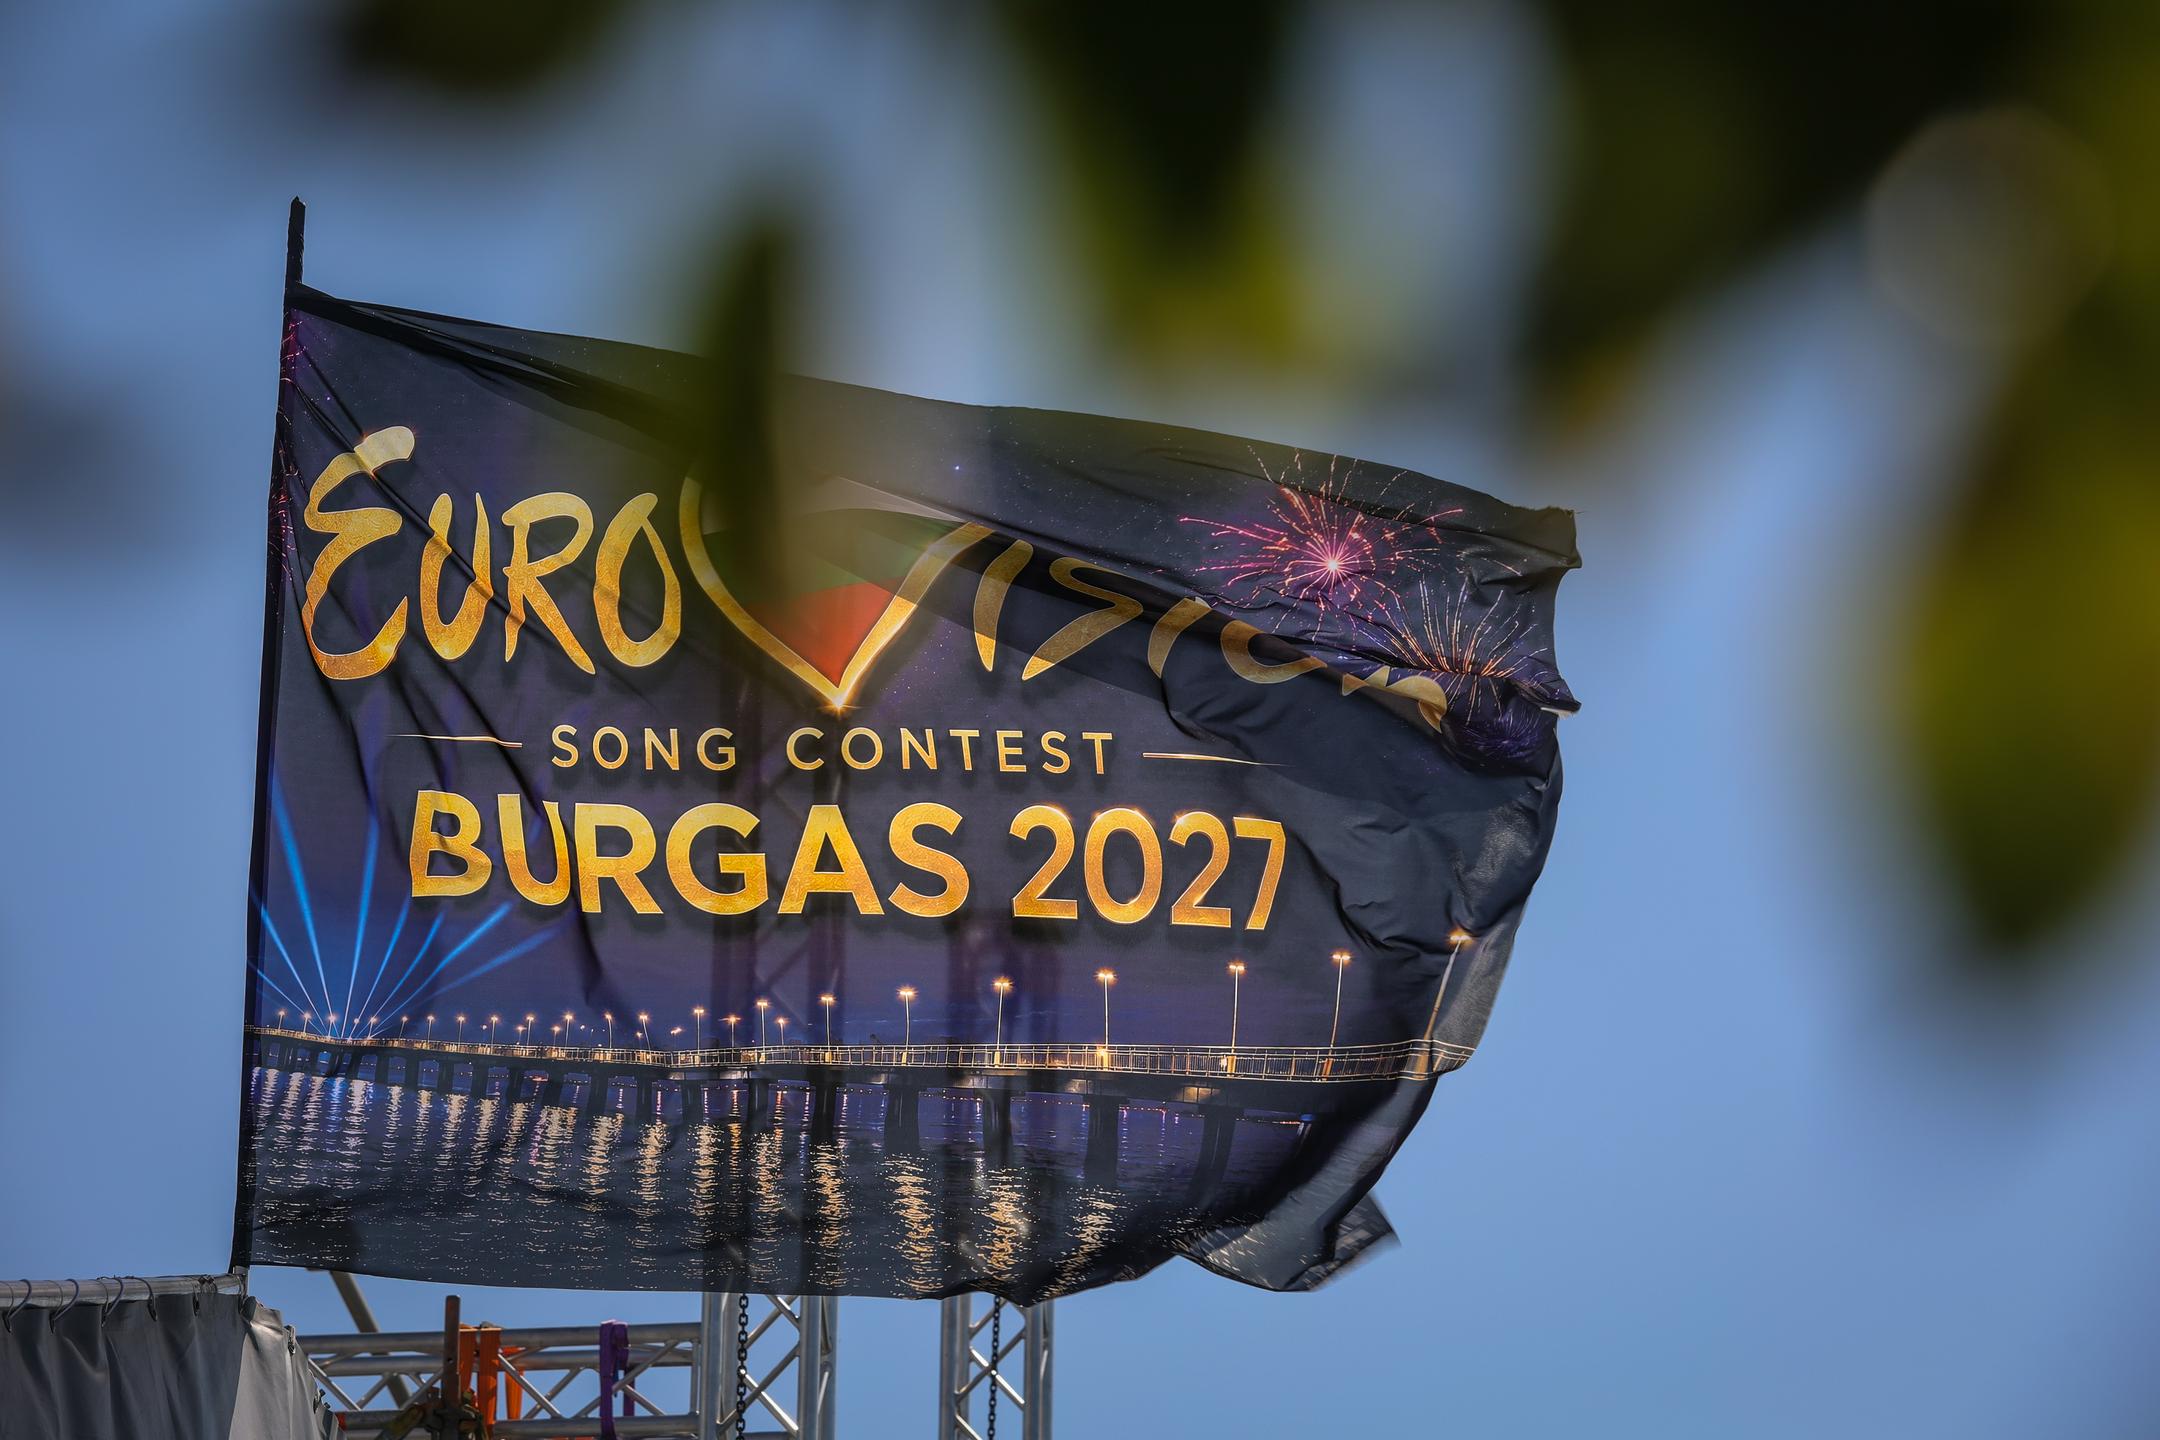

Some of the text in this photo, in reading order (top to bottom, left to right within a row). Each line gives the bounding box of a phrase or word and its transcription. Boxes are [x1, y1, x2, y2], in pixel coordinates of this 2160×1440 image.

[551, 724, 1113, 774] SONG CONTEST
[410, 790, 1286, 930] BURGAS 2027
